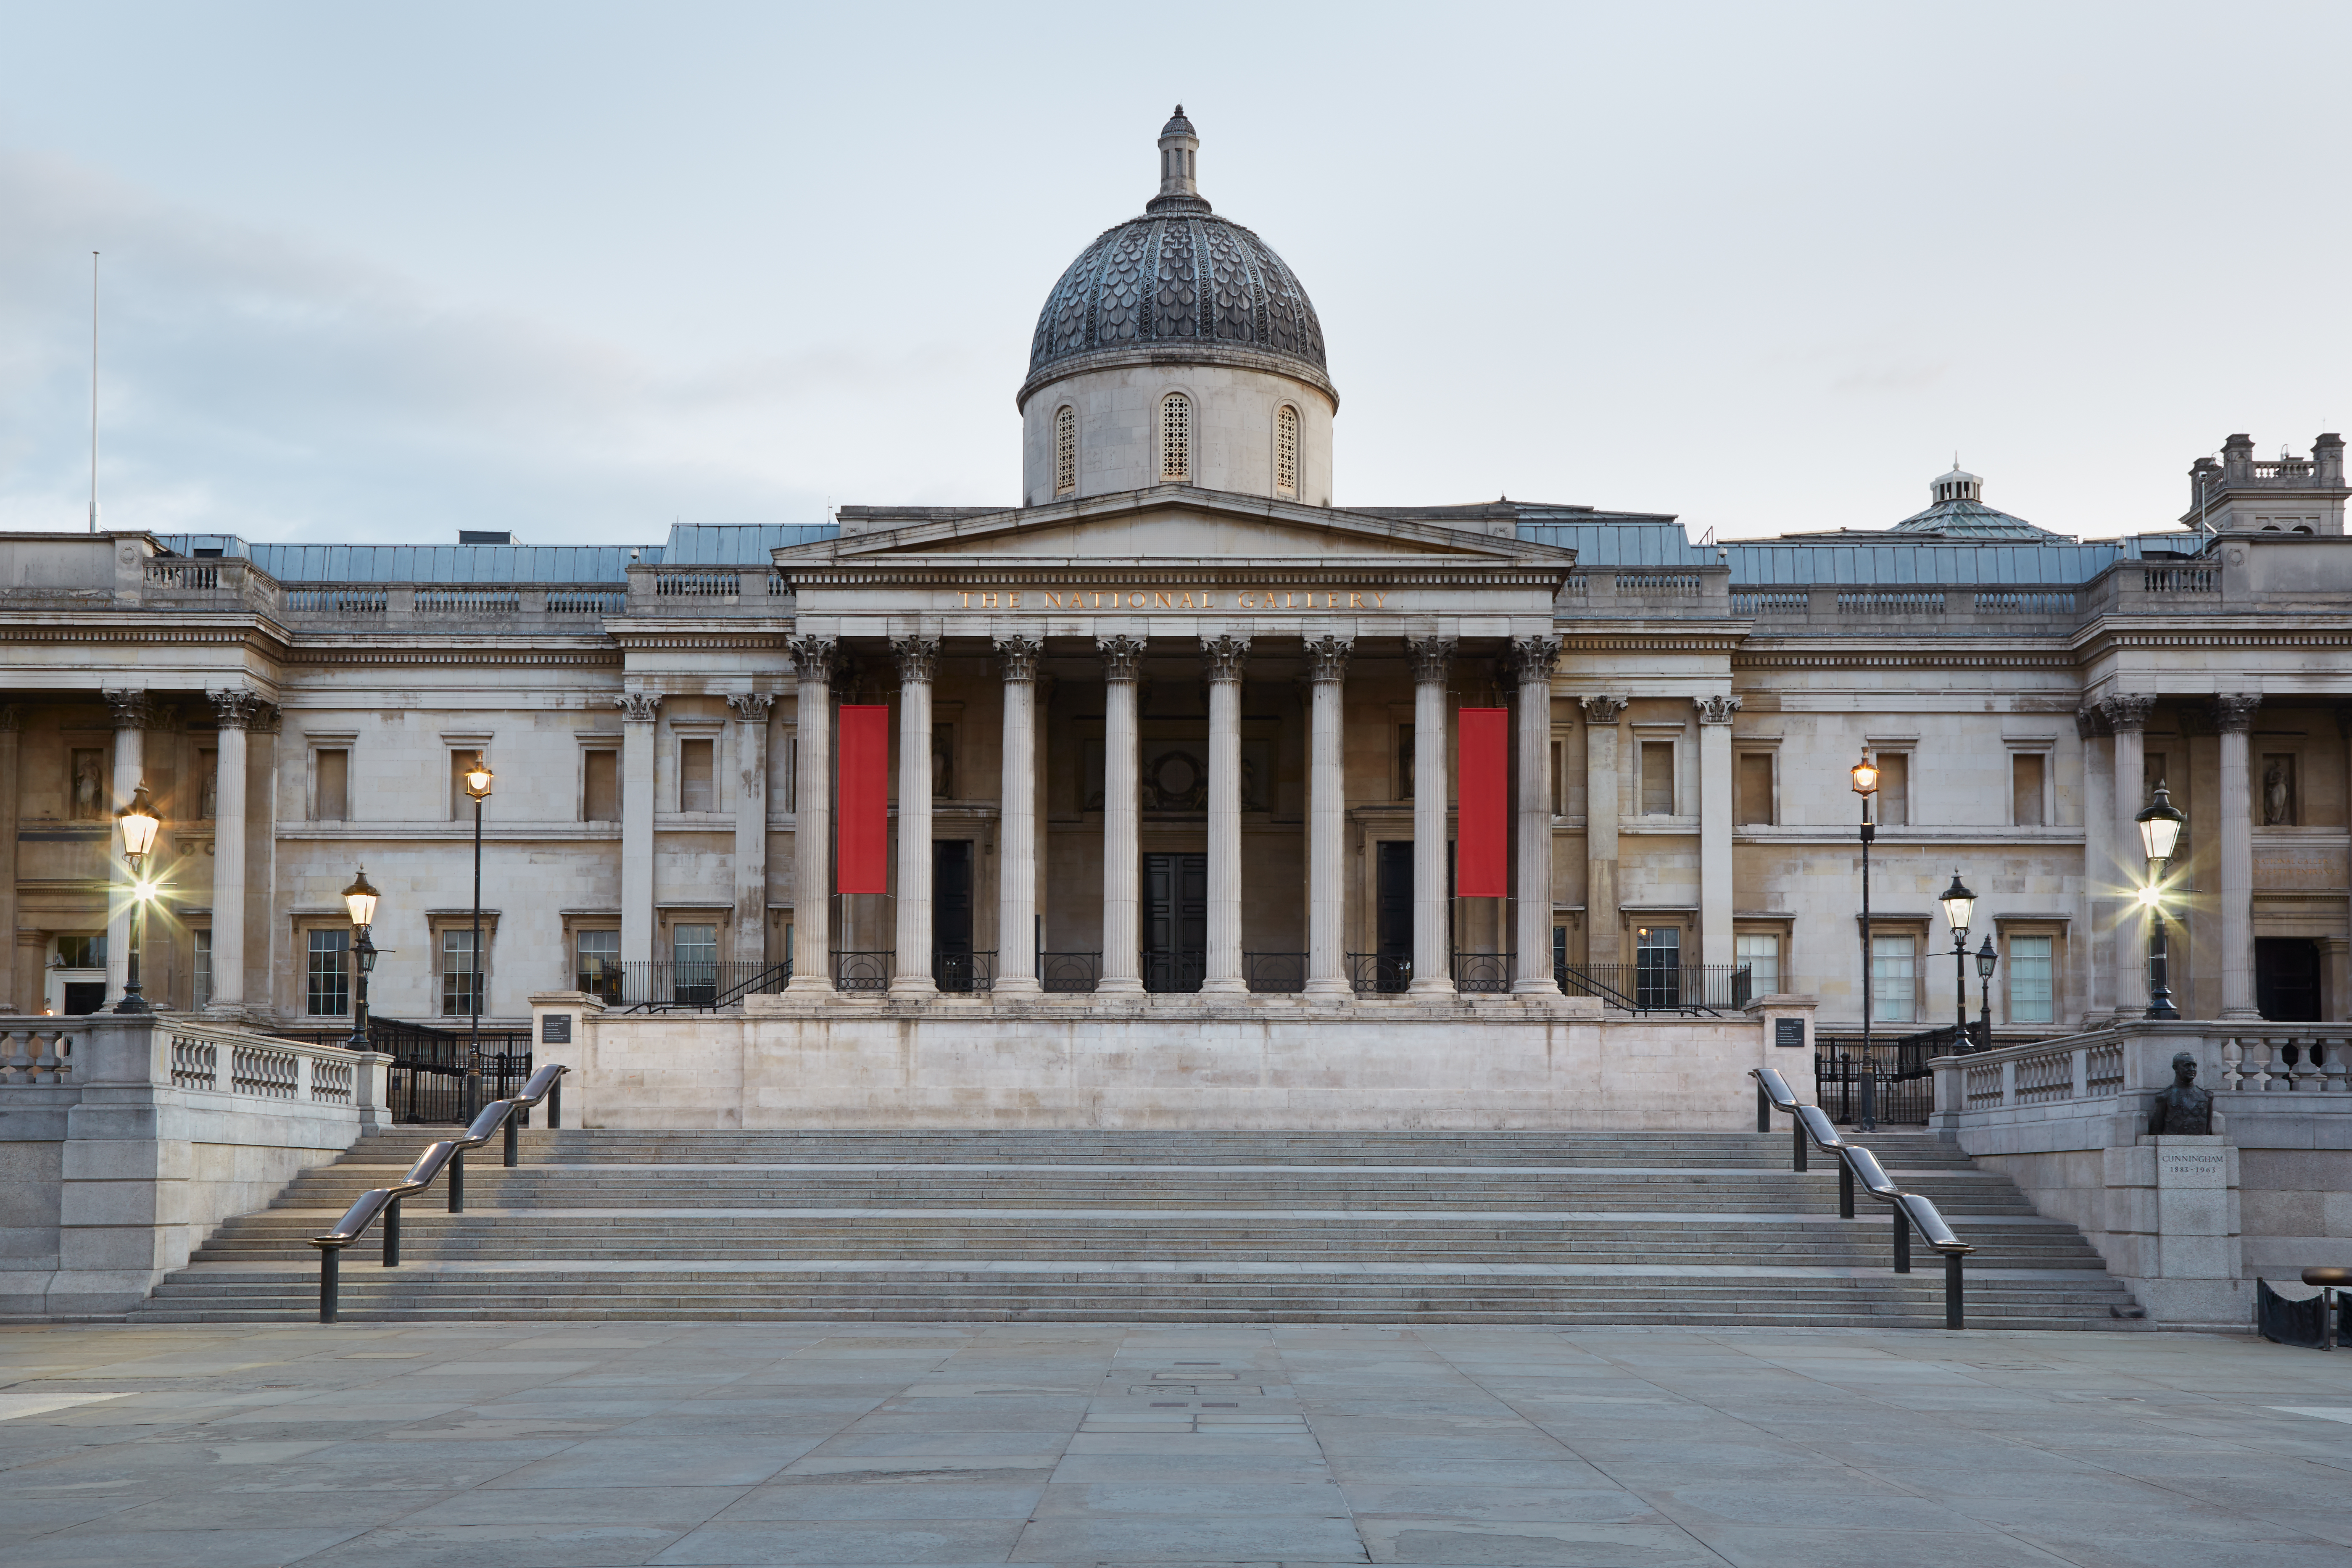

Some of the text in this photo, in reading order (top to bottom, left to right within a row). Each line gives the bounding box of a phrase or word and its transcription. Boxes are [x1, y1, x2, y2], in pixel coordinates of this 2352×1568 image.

[957, 591, 1390, 609] THE NATIONAL GALLERY
